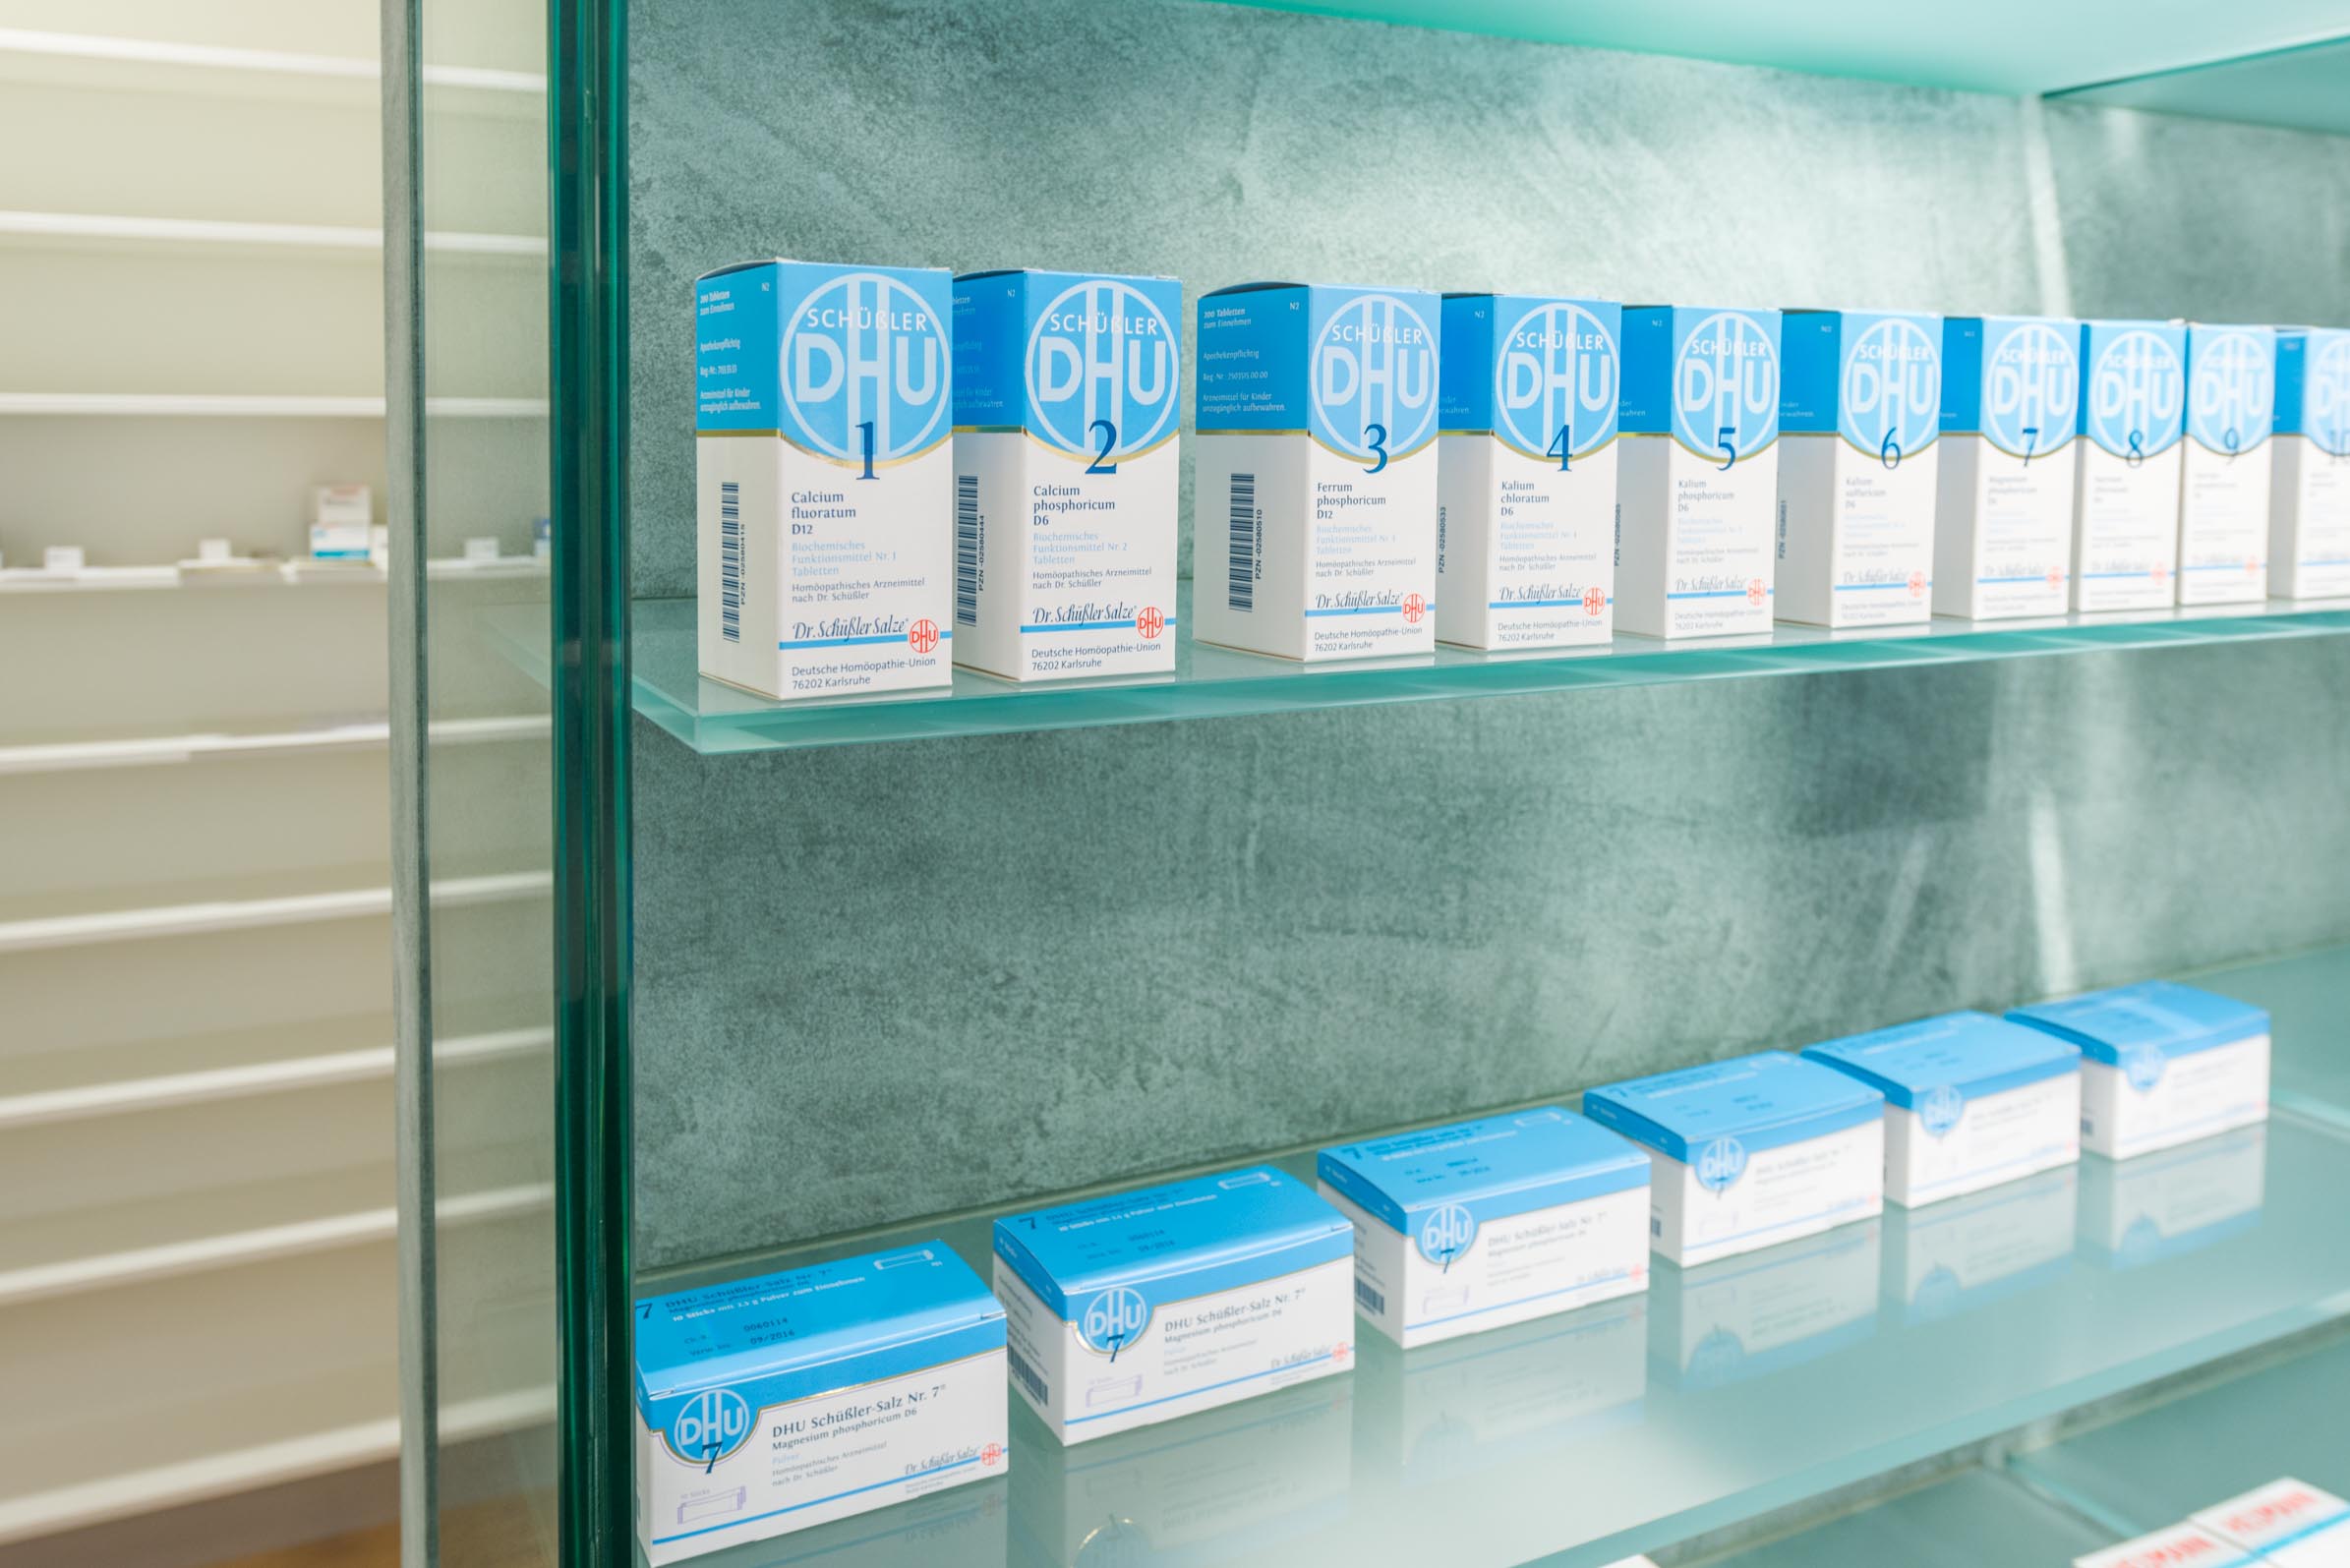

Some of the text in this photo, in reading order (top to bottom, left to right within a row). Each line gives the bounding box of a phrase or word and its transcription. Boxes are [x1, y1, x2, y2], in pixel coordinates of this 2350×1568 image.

[807, 307, 927, 331] SCHÜßLER
[1217, 308, 1246, 317] Tabletten
[1050, 313, 1158, 335] SCHÜßLER
[1331, 324, 1422, 345] SCHÜßLER
[795, 280, 936, 460] DHU
[1039, 287, 1166, 455] DHU
[1322, 300, 1429, 455] DHU
[1506, 309, 1611, 453] DHU
[1685, 319, 1771, 451] DHU
[1852, 323, 1933, 451] DHU
[1994, 328, 2072, 453] DHU
[2100, 335, 2175, 455] DHU
[855, 421, 880, 480] 1
[1086, 419, 1117, 474] 2
[1363, 423, 1388, 474] 3
[1546, 425, 1573, 472] 4
[1717, 427, 1736, 472] 5
[1882, 427, 1901, 470] 6
[2023, 428, 2038, 468] 7
[2127, 429, 2144, 468] 8
[1033, 485, 1081, 496] Calcium
[1318, 482, 1353, 493] Ferrum
[1502, 481, 1535, 492] Kalium
[1678, 480, 1707, 489] Kalium
[792, 492, 845, 504] Calcium
[1033, 499, 1115, 515] phosphoricum
[1318, 495, 1386, 508] phosphoricum
[1500, 493, 1550, 503] chloratum
[792, 507, 856, 520] fluoratum
[1033, 515, 1049, 526] D6
[1318, 509, 1333, 520] D12
[1500, 507, 1514, 516] D6
[792, 523, 813, 535] D12
[1032, 532, 1098, 543] Biochemisches
[792, 541, 865, 552] Biochemisches
[1032, 543, 1104, 553] Funktionsmittel
[792, 552, 872, 564] Funktionsmittel
[1032, 555, 1075, 565] Tabletten
[793, 565, 840, 577] Tabletten
[1032, 566, 1152, 582] Homöopathisches Arzneimittel
[1316, 569, 1332, 578] nach
[793, 578, 925, 595] Homöopathisches Arzneimittel
[1032, 580, 1052, 590] nach
[1068, 578, 1102, 588] Schüßler
[793, 590, 870, 603] nach Dr. Schüßler
[1334, 589, 1376, 612] Schüßler
[1518, 584, 1557, 606] Schüßler
[1584, 588, 1604, 616] DHU
[1055, 603, 1104, 627] Schüßler
[1404, 594, 1424, 623] DHU
[818, 616, 872, 643] Schüßler
[1139, 607, 1162, 639] DHU
[1498, 622, 1531, 631] Deutsche
[911, 619, 937, 654] DHU
[1315, 626, 1423, 641] Deutsche Homöopathie-Union
[1032, 642, 1161, 659] Deutsche Homöopathie-Union
[1315, 641, 1373, 653] 76202 Karlsruhe
[792, 657, 936, 676] Deutsche Homöopathie-Union
[1032, 659, 1102, 671] 76202 Karlsruhe
[793, 674, 871, 690] 76202 Karlsruhe
[1425, 1205, 1470, 1263] DHU
[1439, 1248, 1455, 1275] 7
[760, 1292, 791, 1304] Pulver
[635, 1303, 654, 1320] 7
[1089, 1288, 1142, 1353] DHU
[1164, 1319, 1194, 1333] DHU
[750, 1329, 795, 1345] 09/2016
[1107, 1334, 1126, 1364] 7
[773, 1390, 927, 1438] DHU Schüßler-Salz Nr.
[680, 1392, 743, 1461] DHU
[773, 1408, 917, 1452] Magnesium phosphoricum D6
[702, 1441, 723, 1475] 7
